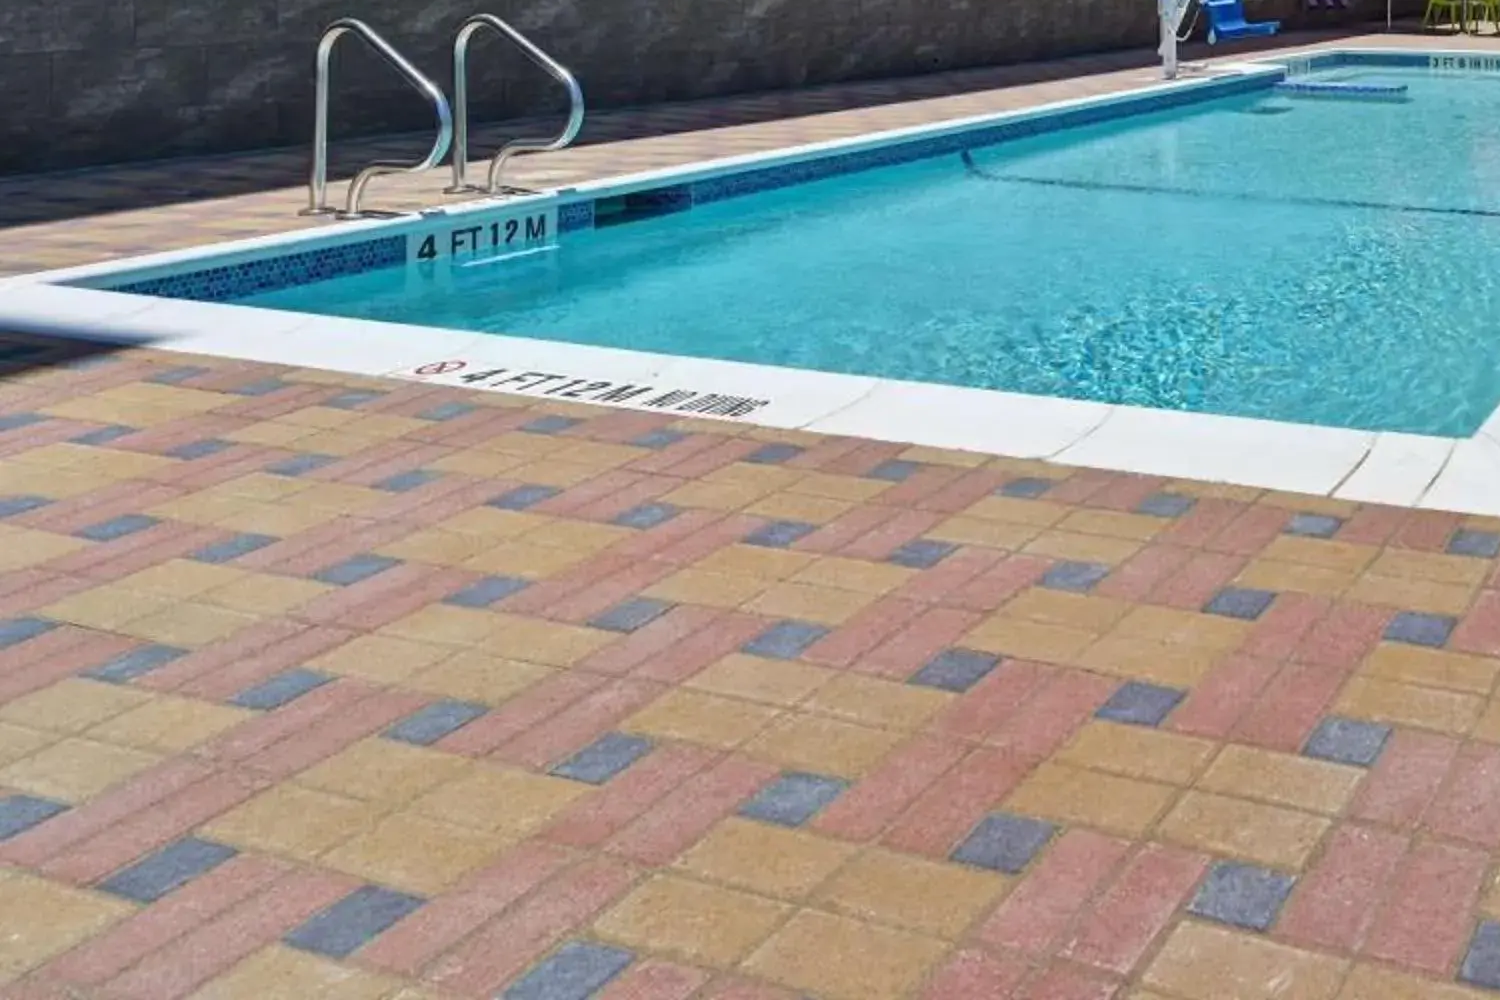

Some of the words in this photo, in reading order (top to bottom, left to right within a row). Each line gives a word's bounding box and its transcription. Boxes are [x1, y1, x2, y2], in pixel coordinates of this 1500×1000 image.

[417, 234, 437, 259] 4
[451, 226, 483, 254] FT
[460, 368, 507, 384] 4
